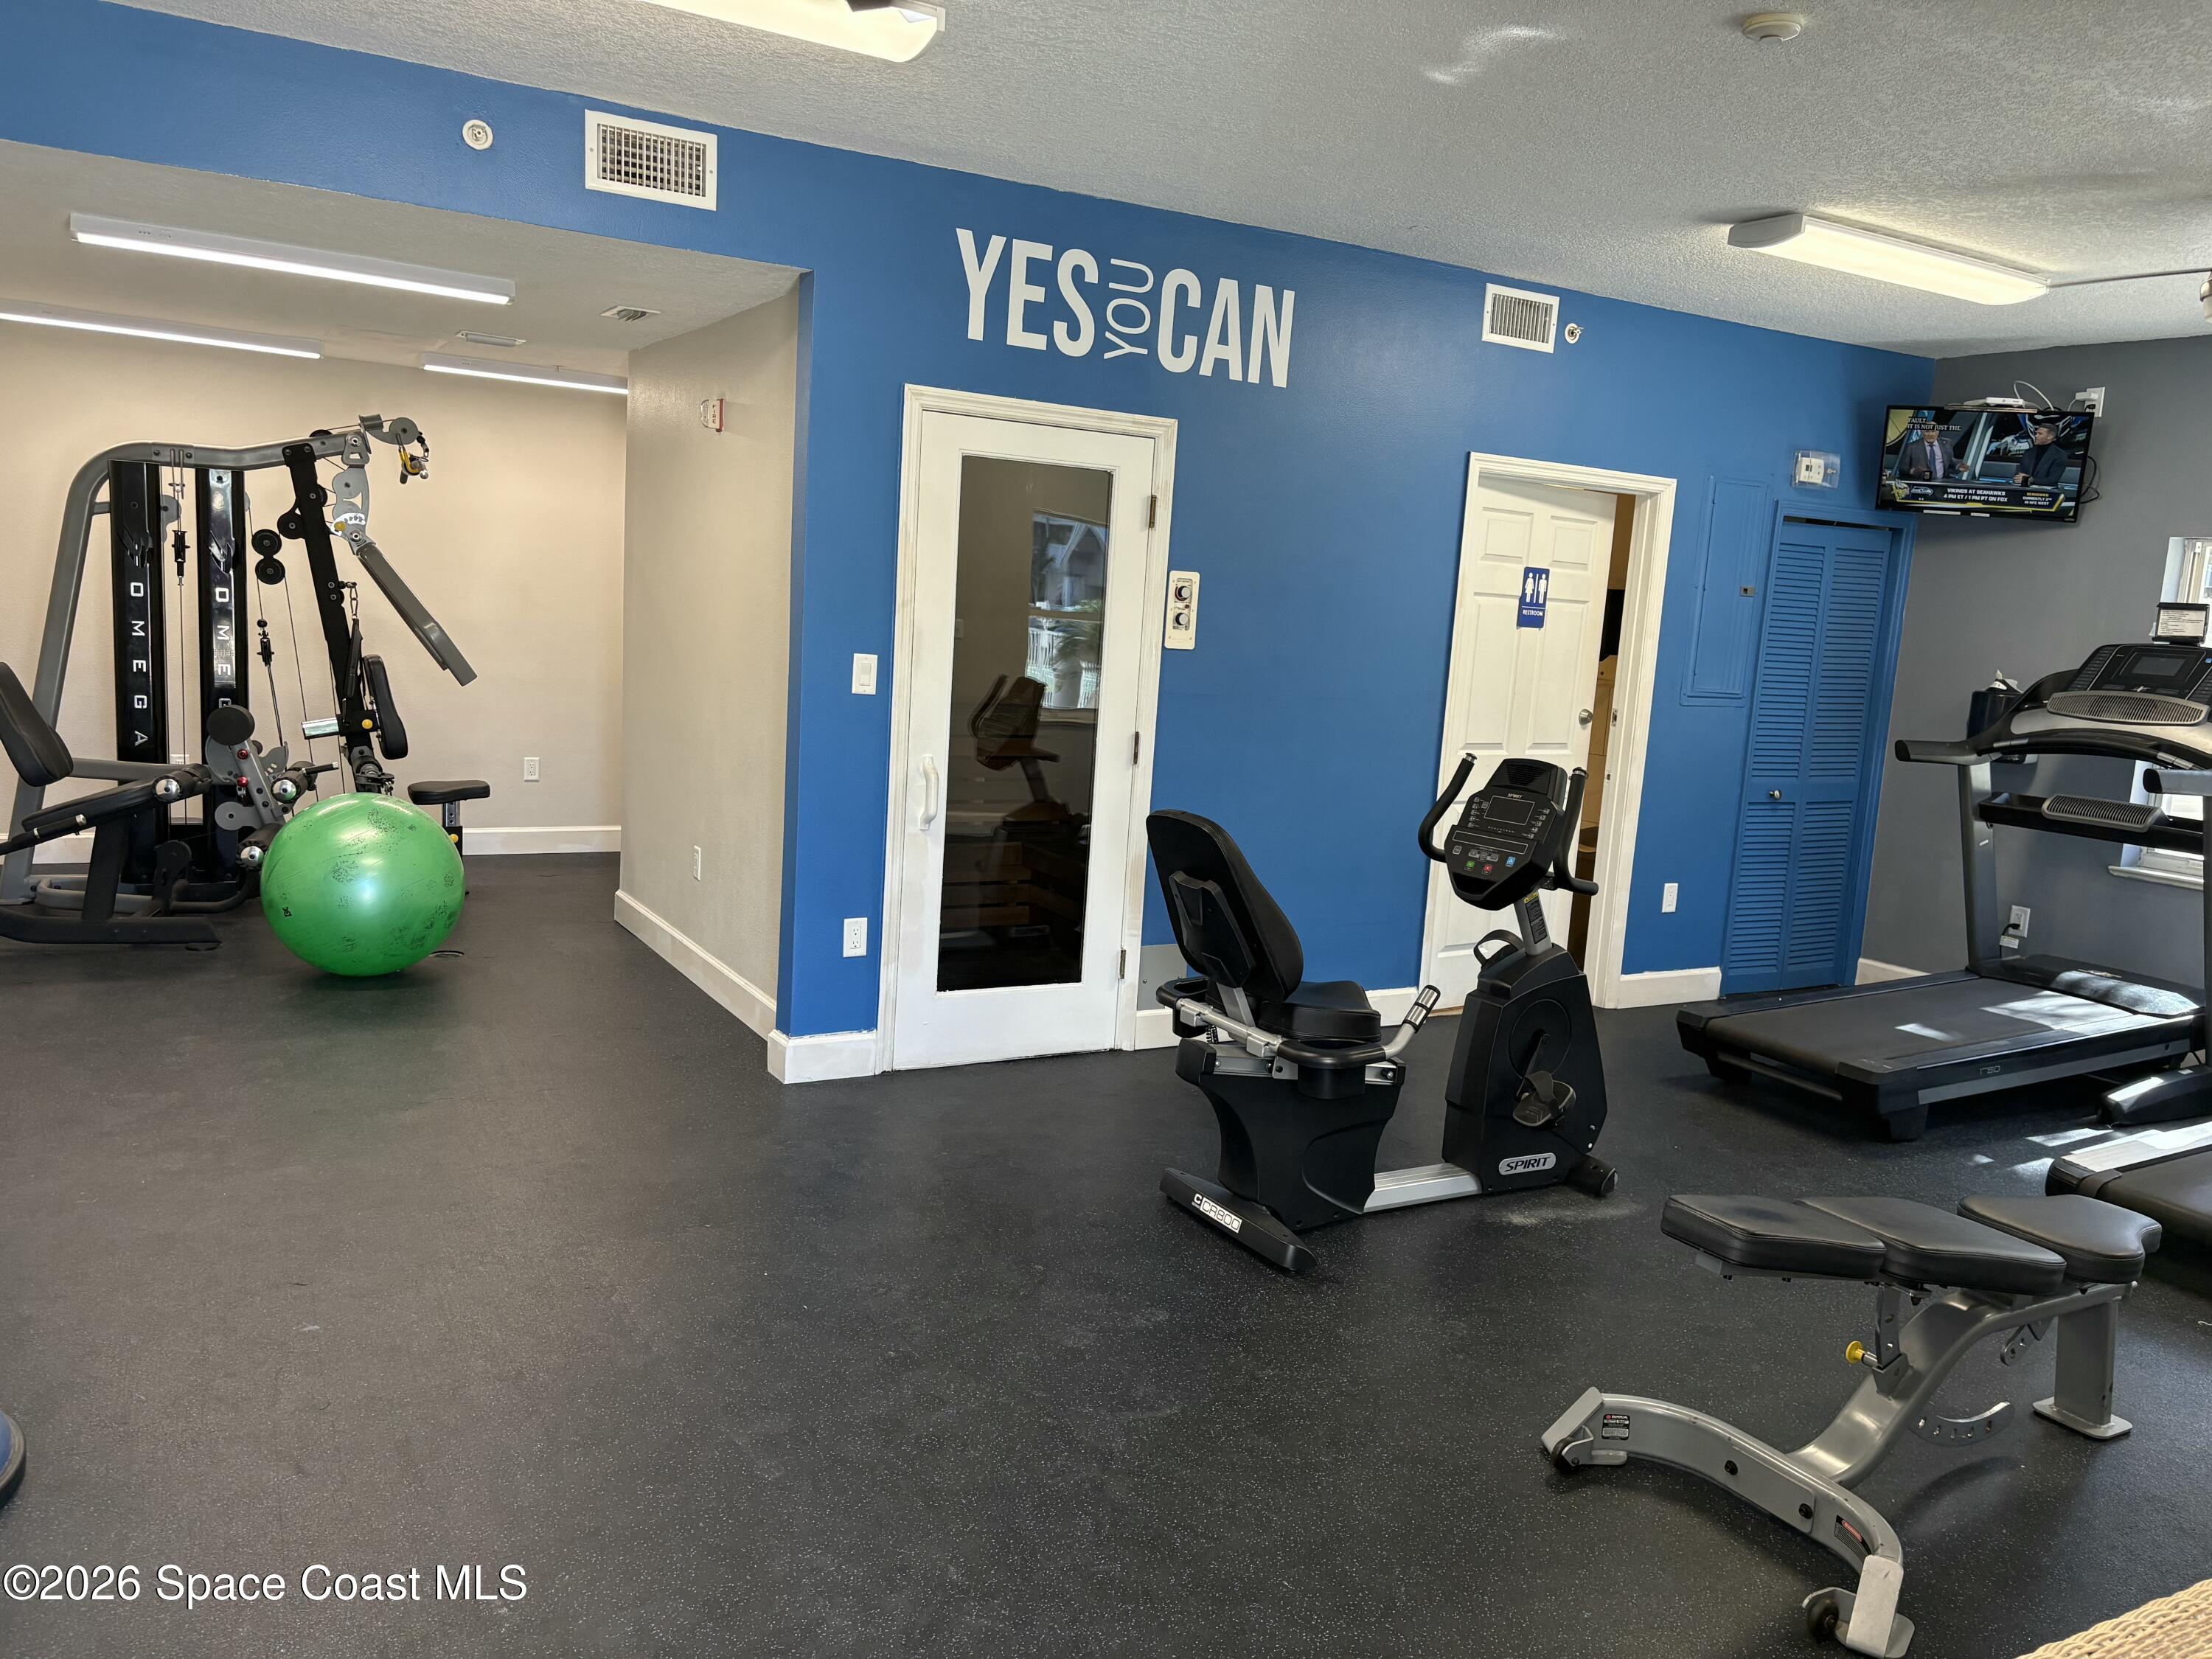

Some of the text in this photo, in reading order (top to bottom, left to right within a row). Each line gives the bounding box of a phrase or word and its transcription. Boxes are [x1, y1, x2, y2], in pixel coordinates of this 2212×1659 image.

[956, 227, 1295, 389] YES YOU CAN
[130, 582, 148, 747] OMEGA
[215, 587, 232, 708] OMEG
[1202, 1200, 1240, 1231] CR800
[1504, 1156, 1551, 1172] SPIRIT
